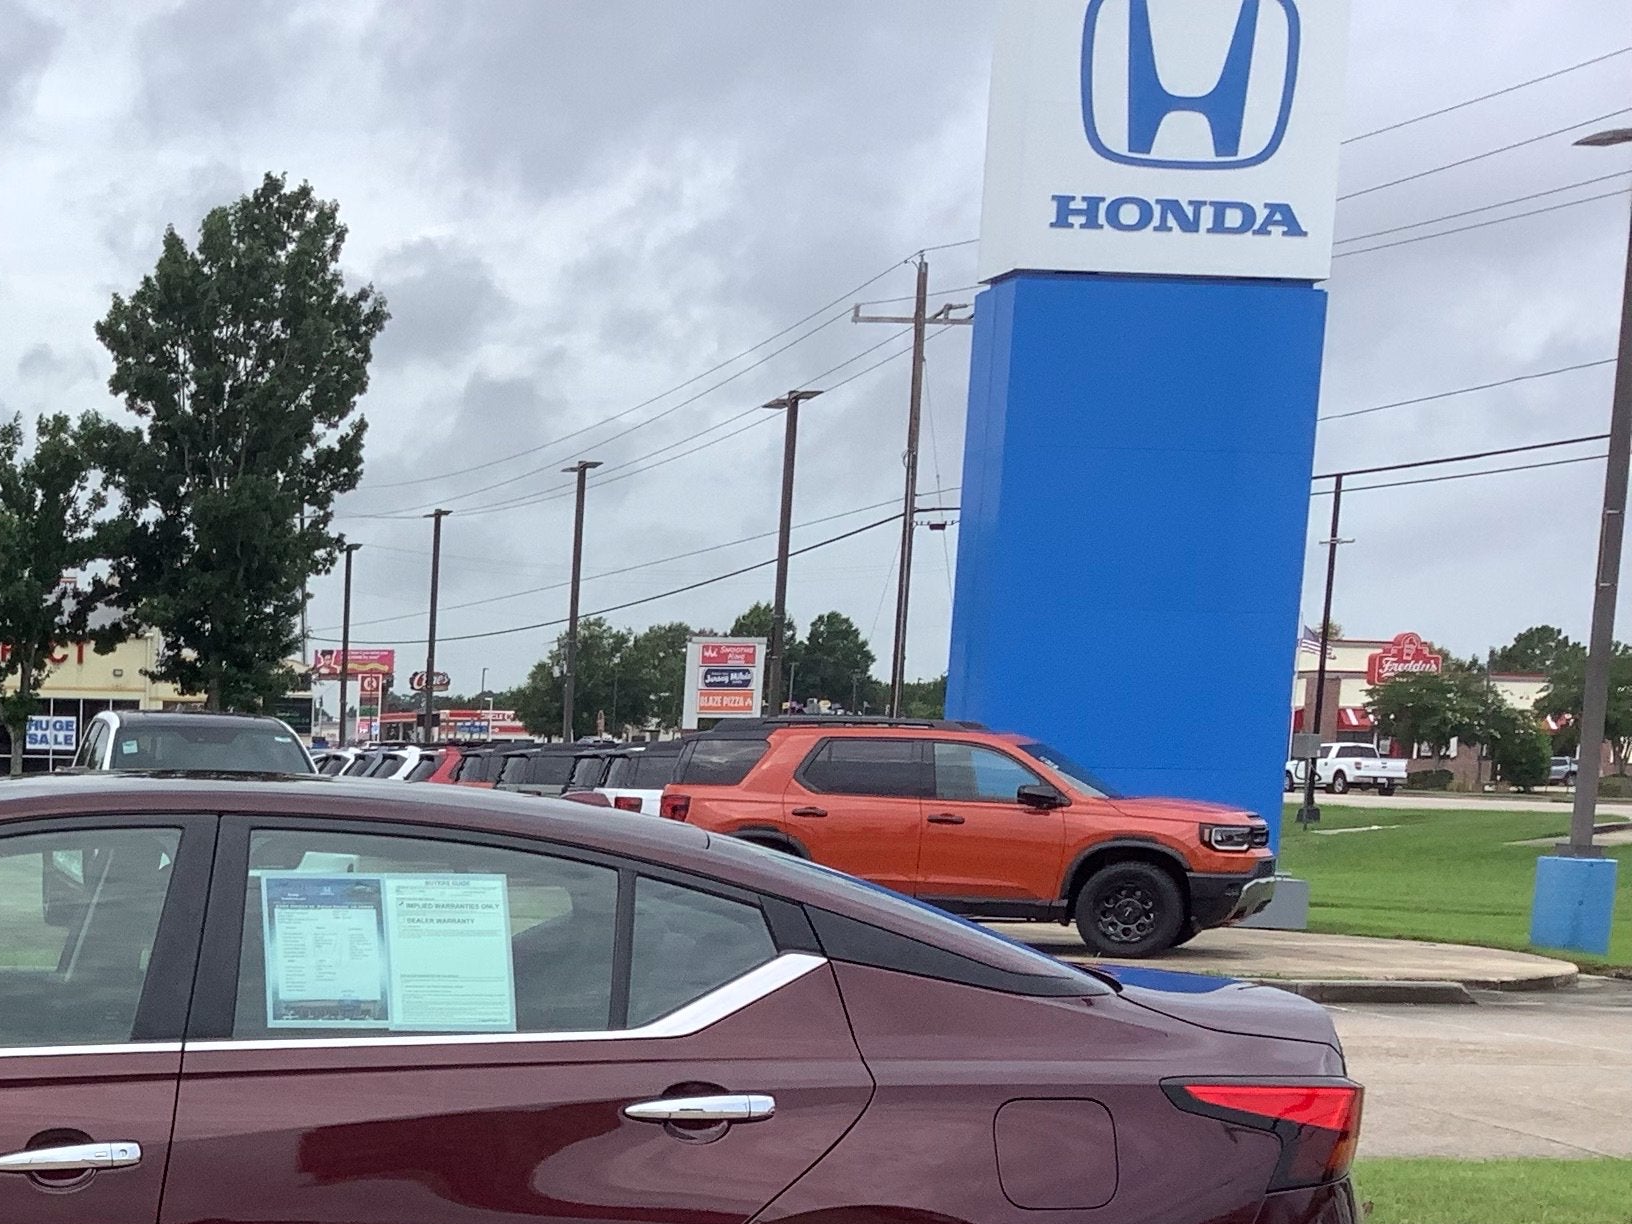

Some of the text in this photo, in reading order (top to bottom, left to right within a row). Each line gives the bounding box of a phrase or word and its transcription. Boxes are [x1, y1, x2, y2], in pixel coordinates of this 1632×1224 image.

[1050, 195, 1308, 237] HONDA
[700, 696, 744, 707] BLAZE PIZZA
[28, 720, 74, 731] HUGE
[28, 733, 74, 745] SALE
